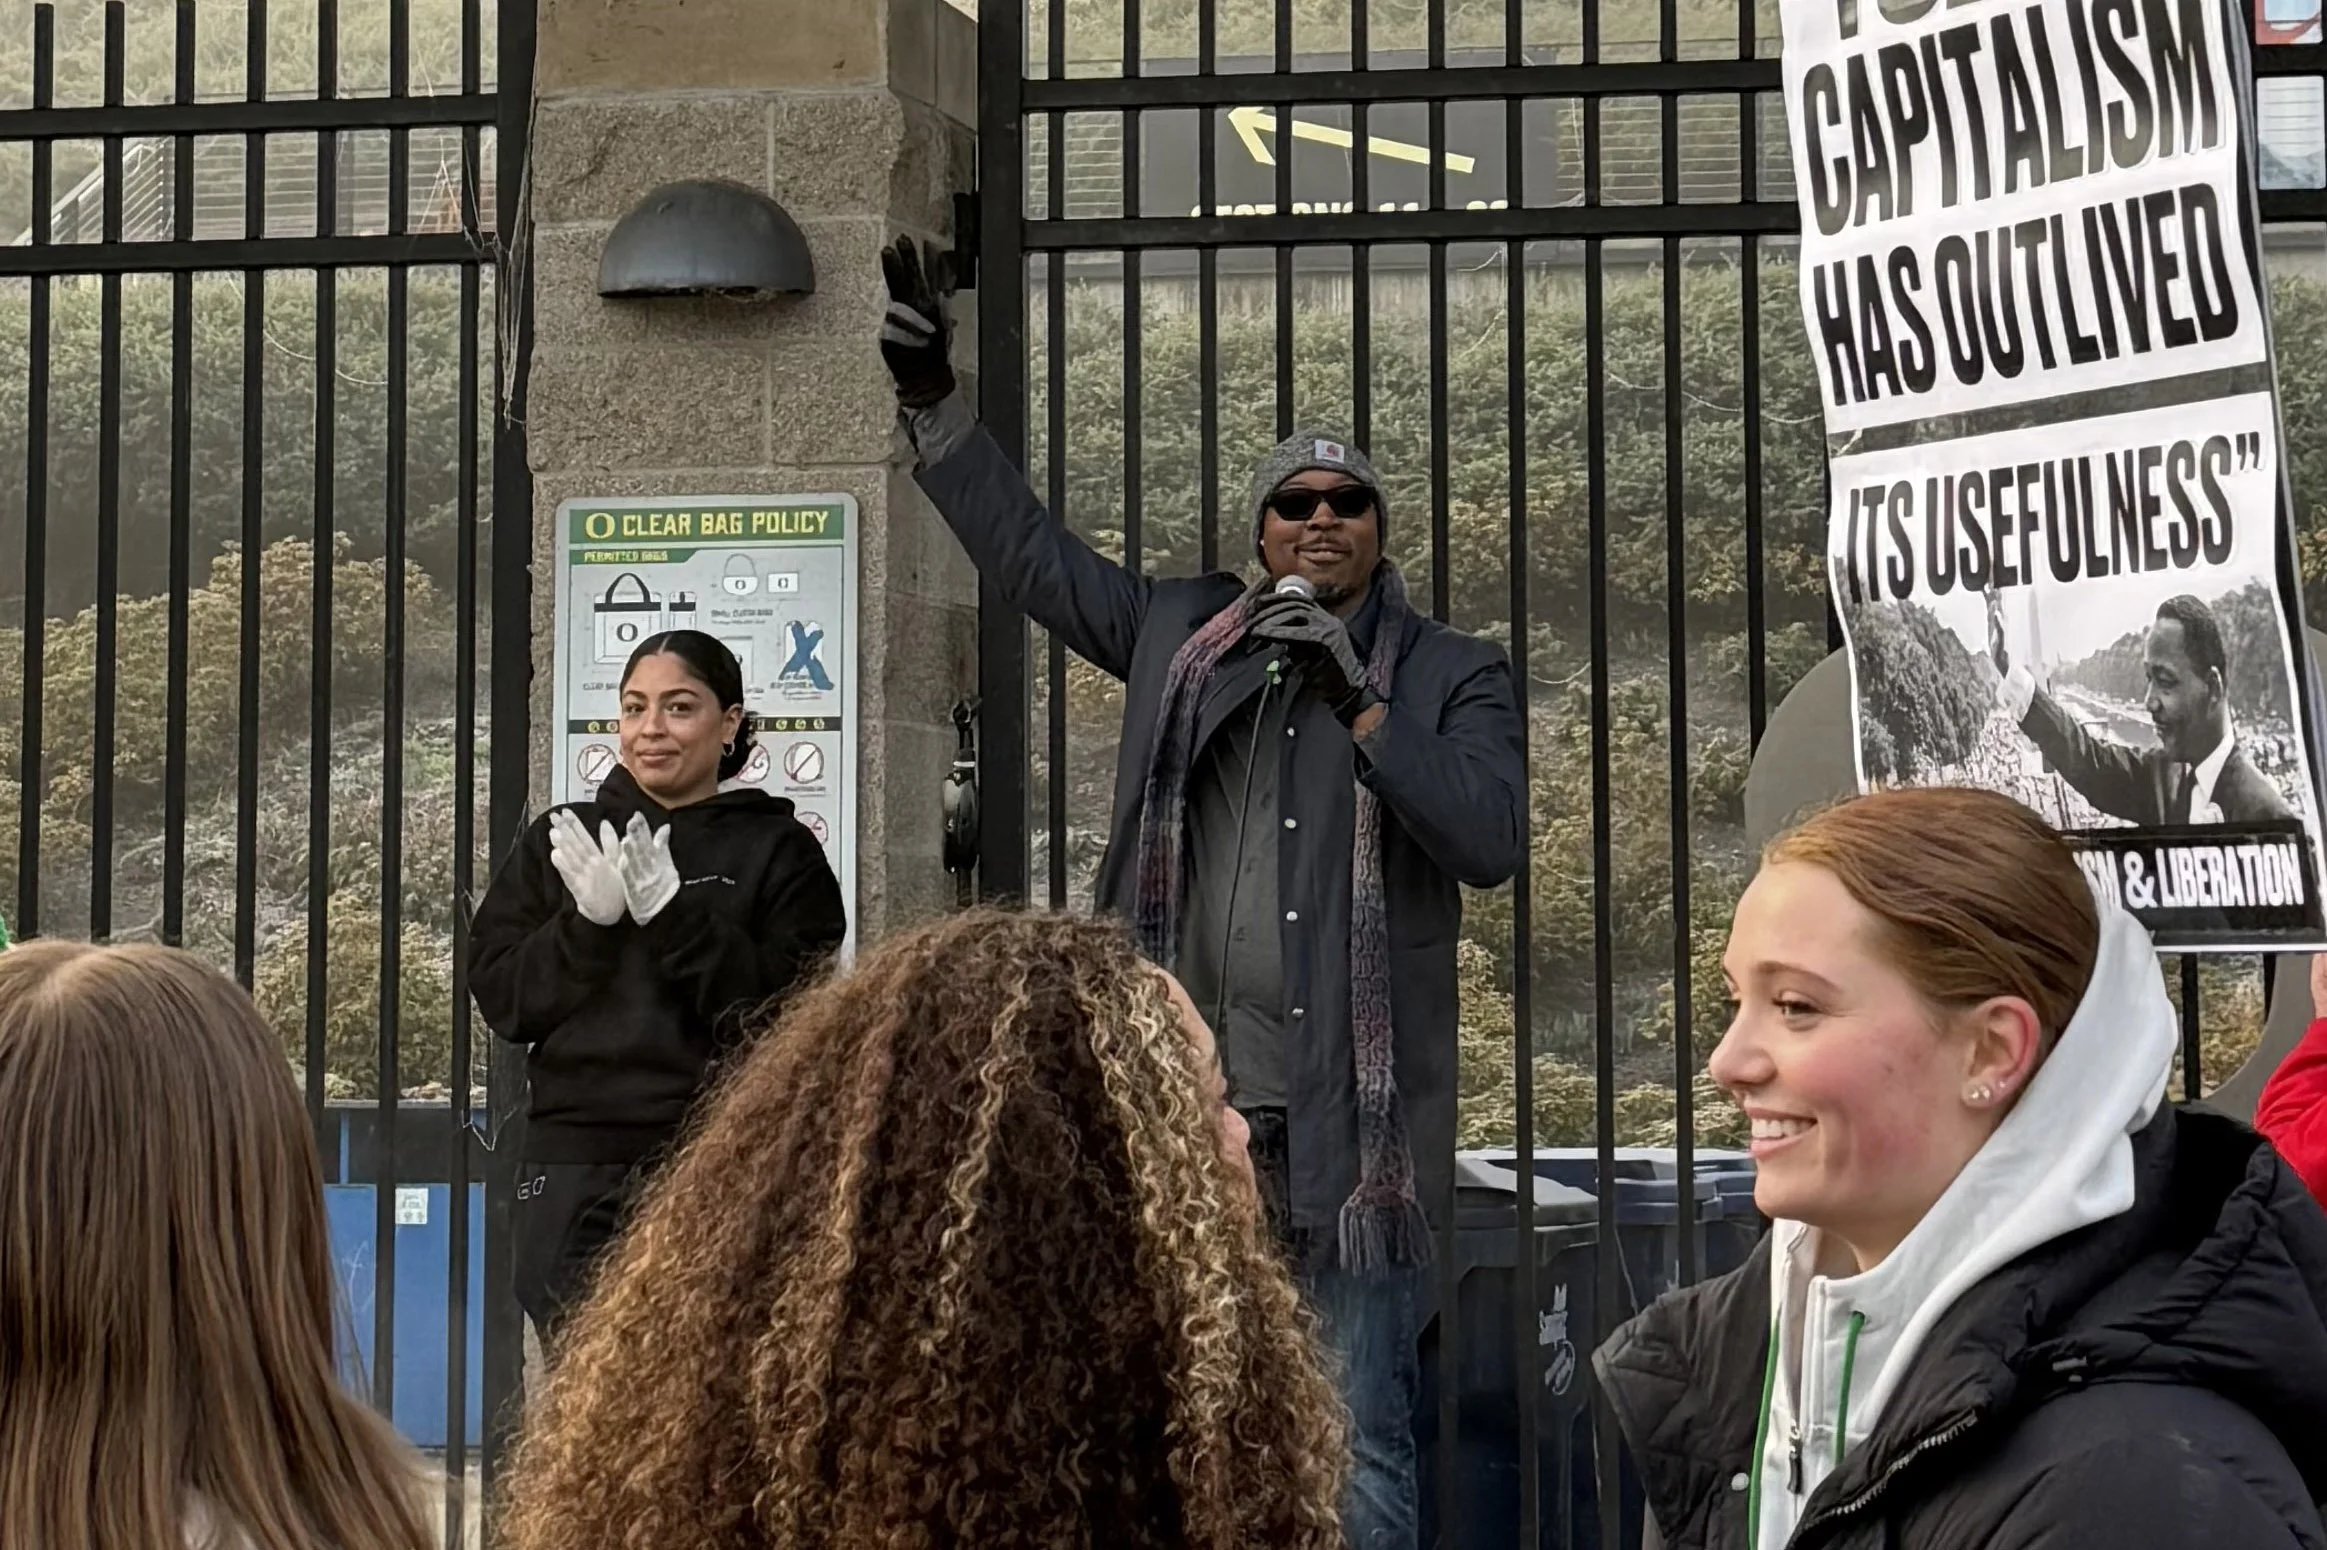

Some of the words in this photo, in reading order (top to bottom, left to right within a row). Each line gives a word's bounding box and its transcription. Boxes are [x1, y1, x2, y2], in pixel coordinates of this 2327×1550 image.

[1803, 0, 2220, 236] CAPITALISM
[1814, 246, 1936, 407] HAS
[1935, 183, 2239, 386] OUTLIVED
[623, 513, 691, 536] CLEAR
[701, 512, 743, 535] BAG
[752, 510, 829, 534] POLICY
[1846, 480, 1914, 603] ITS
[2123, 851, 2158, 909] &
[2155, 842, 2304, 908] LIBERATION
